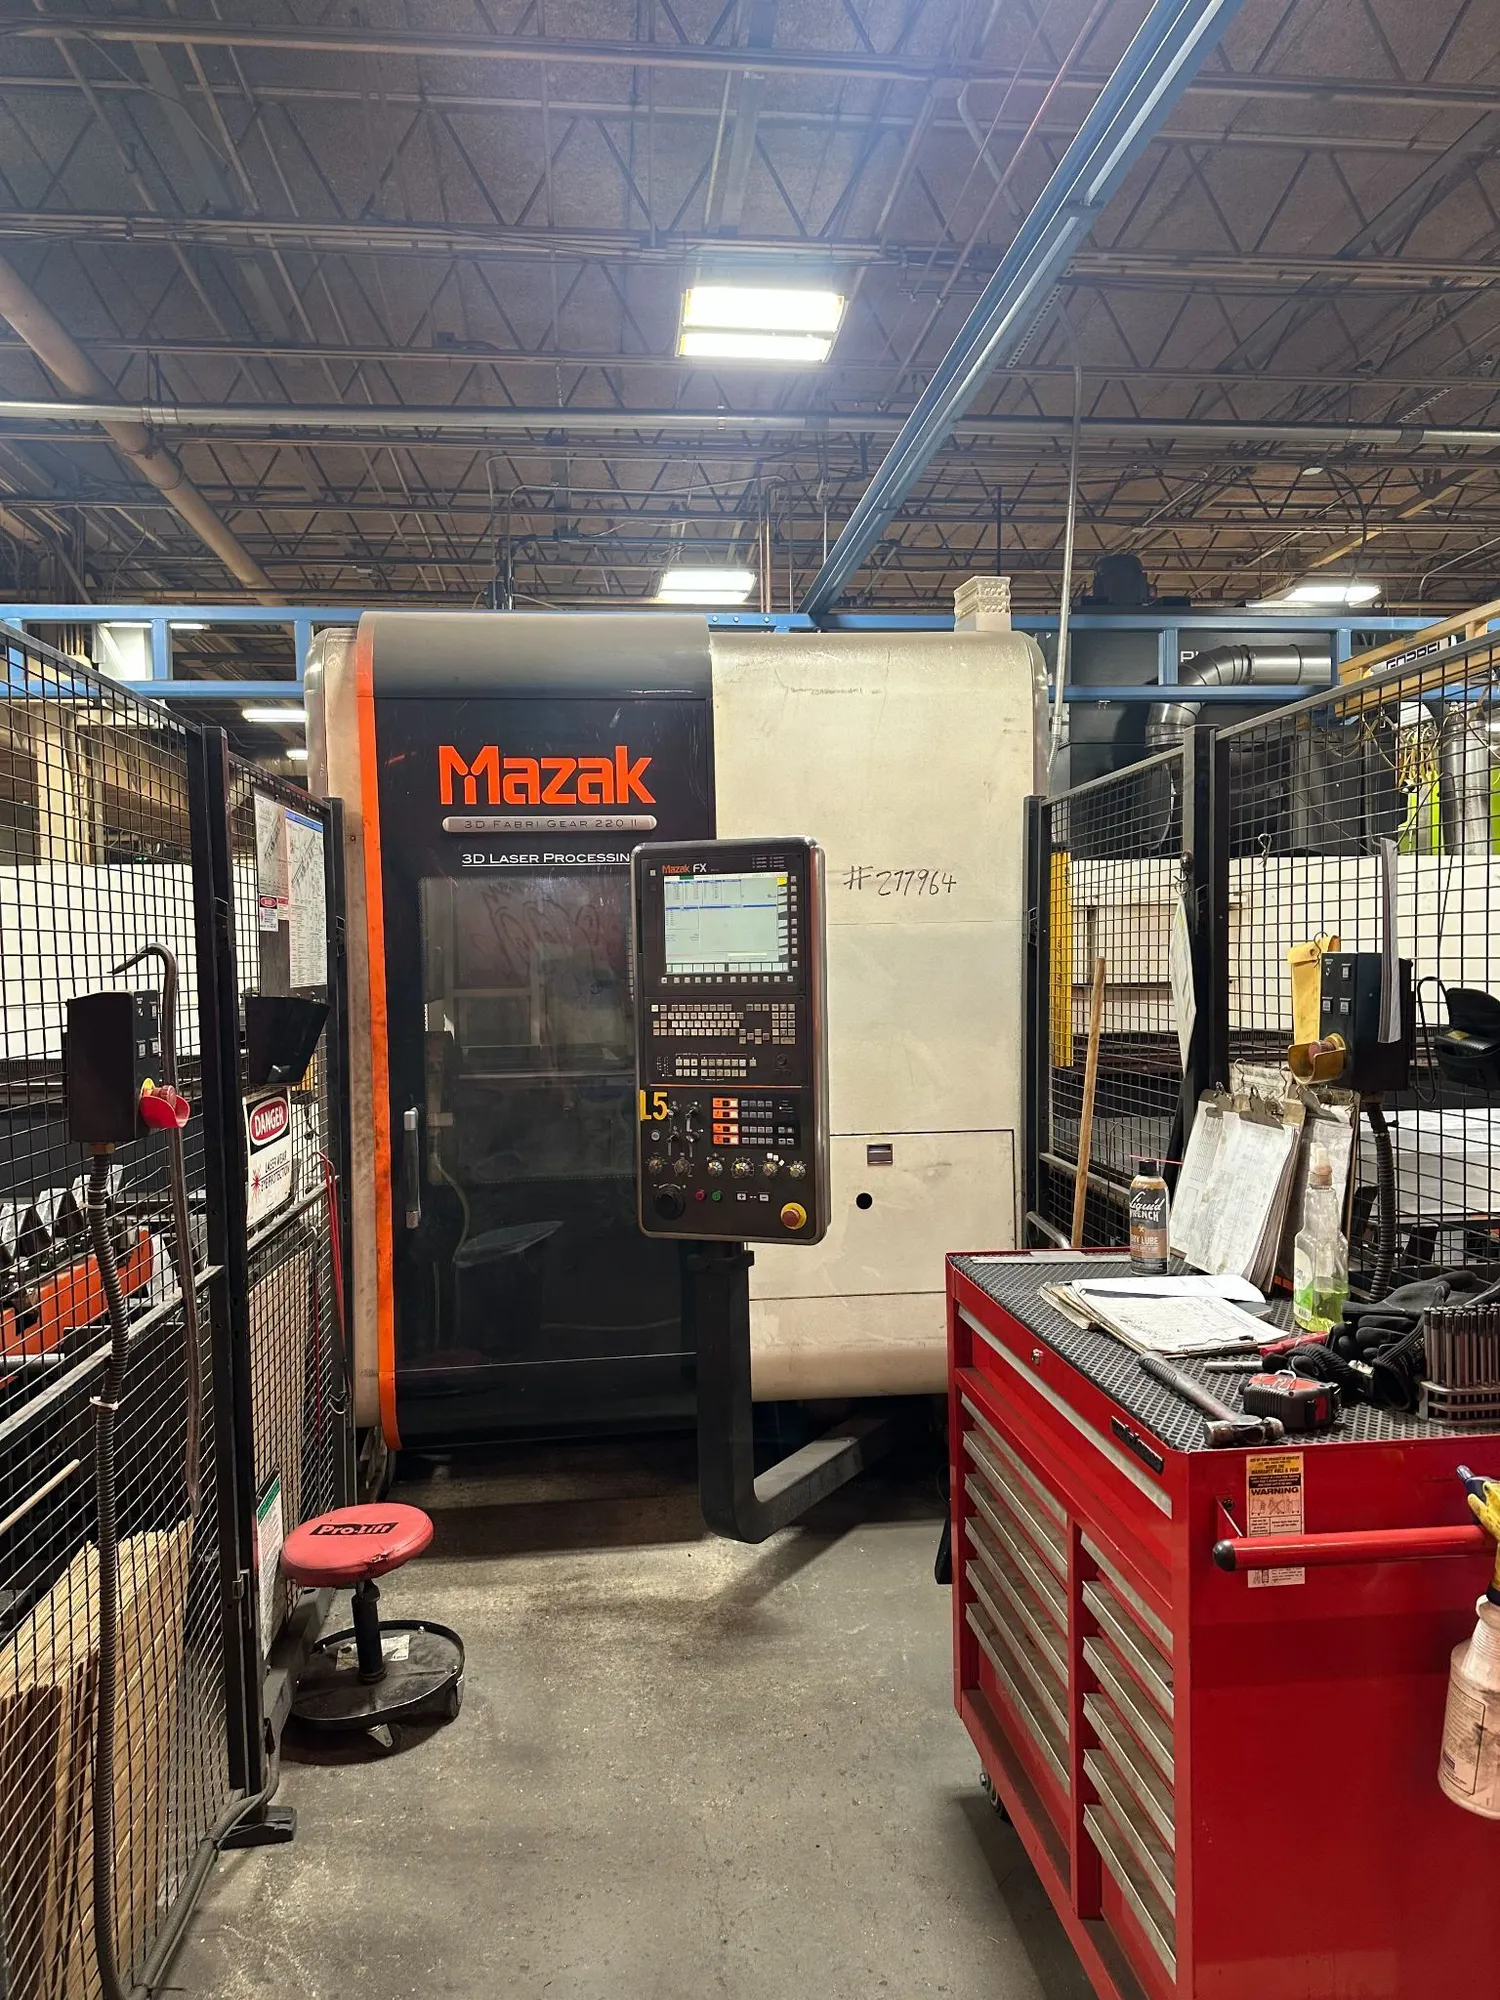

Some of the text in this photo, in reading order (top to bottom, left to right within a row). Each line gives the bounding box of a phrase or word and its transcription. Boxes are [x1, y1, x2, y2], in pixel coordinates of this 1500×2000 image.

[438, 745, 657, 805] Mazak
[464, 820, 485, 829] 3D
[493, 820, 539, 829] FABRI
[547, 819, 589, 828] GEAR
[595, 819, 624, 828] 220
[462, 853, 485, 864] 3D
[489, 853, 539, 864] LASER
[662, 863, 708, 874] Mazak FX
[639, 1089, 668, 1121] L5
[254, 1105, 285, 1137] DANGER
[1129, 1191, 1165, 1212] Liquid
[1141, 1236, 1159, 1245] LUBE
[1251, 1486, 1299, 1496] WARNING
[318, 1524, 390, 1535] Pro-Lift
